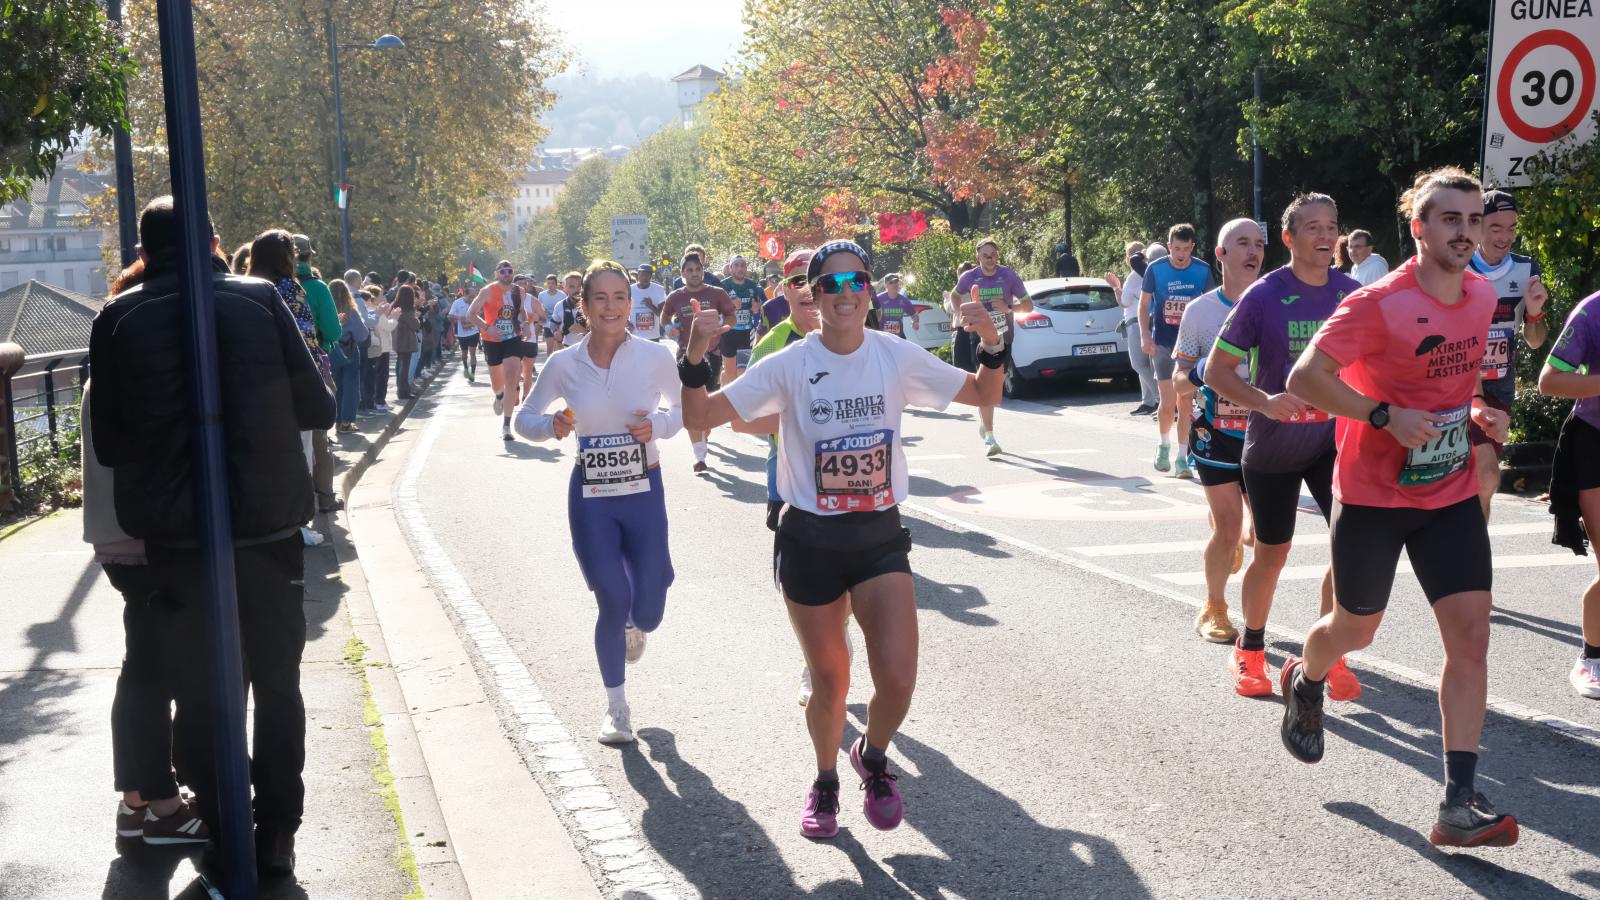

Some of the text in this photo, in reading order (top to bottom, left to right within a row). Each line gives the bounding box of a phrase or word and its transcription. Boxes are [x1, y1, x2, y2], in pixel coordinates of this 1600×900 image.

[1510, 0, 1593, 20] GUNEA
[1521, 69, 1575, 107] 30
[1428, 351, 1467, 368] MENDI
[834, 395, 885, 411] TRAIL2
[836, 405, 885, 420] HEAVEN
[586, 448, 641, 469] 28584
[822, 449, 885, 476] 4933
[1430, 451, 1457, 463] AITOR
[847, 480, 873, 488] DANI
